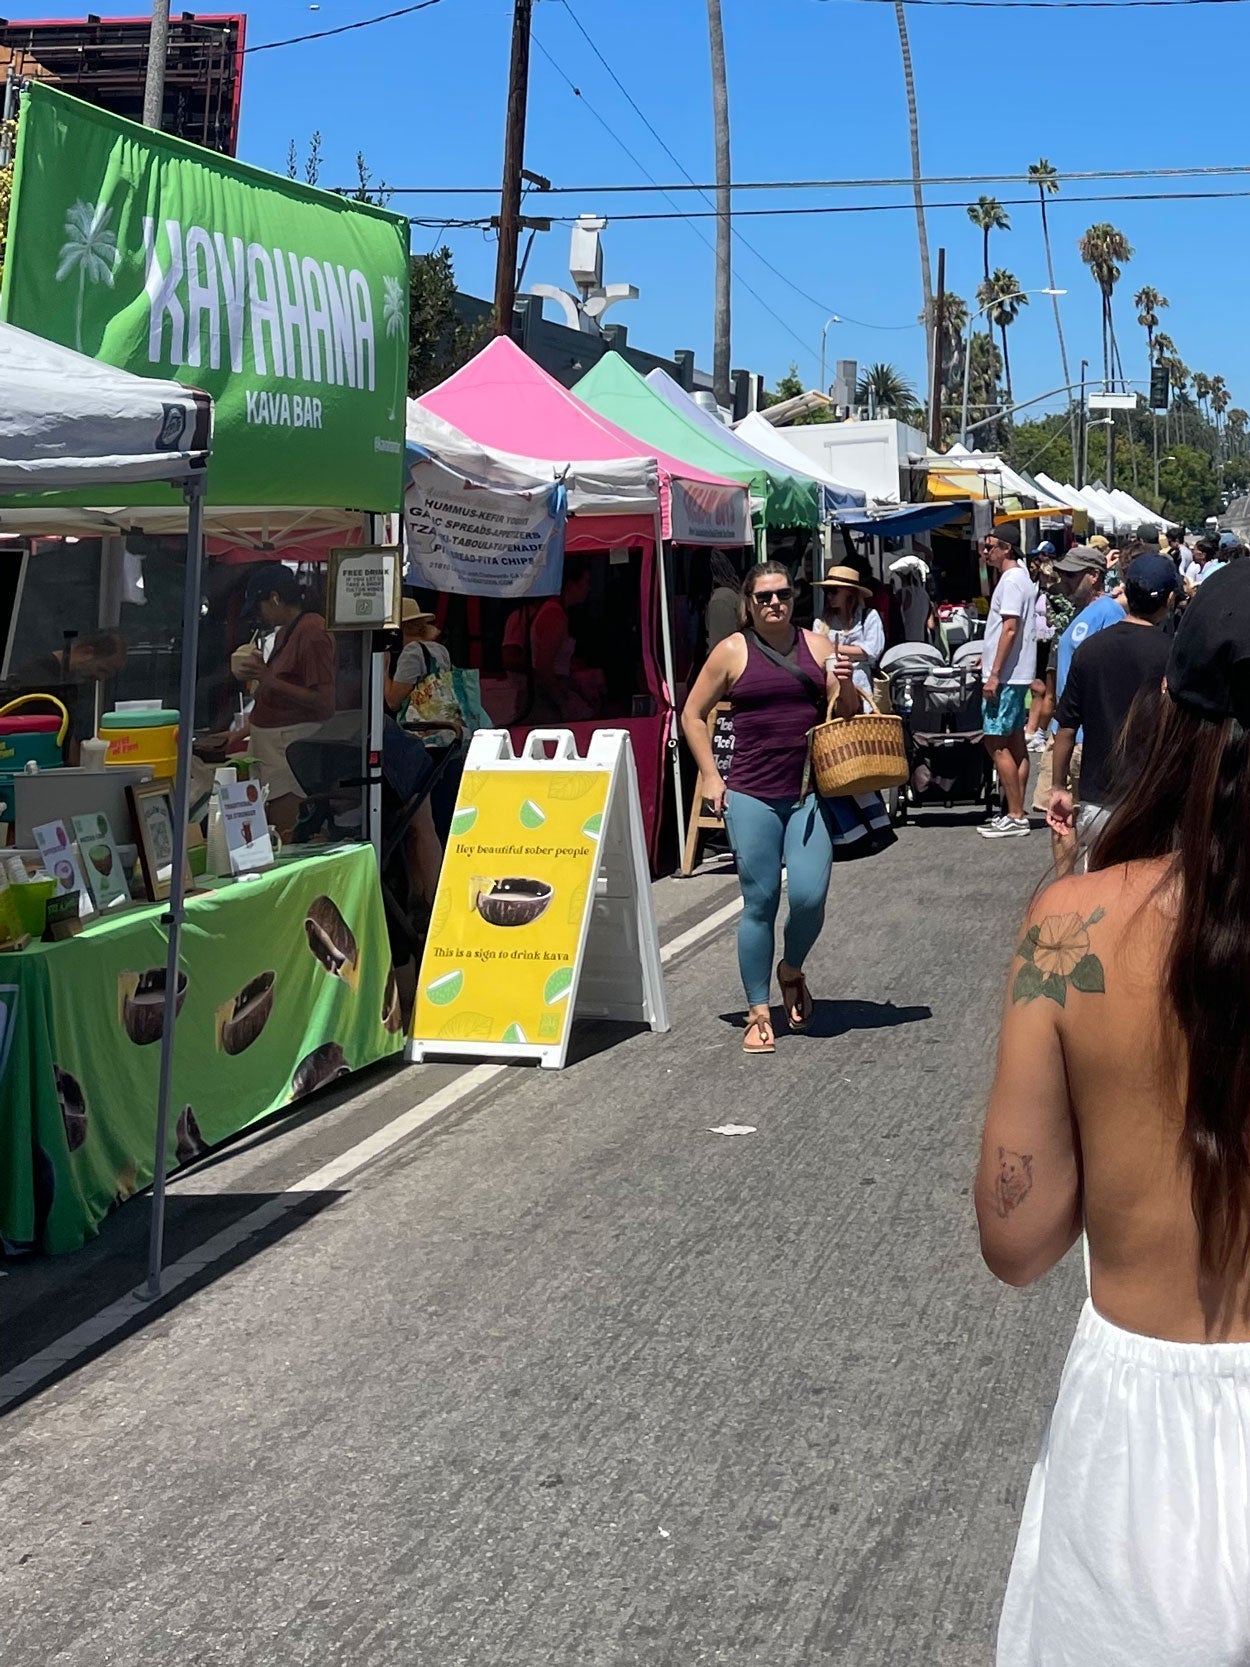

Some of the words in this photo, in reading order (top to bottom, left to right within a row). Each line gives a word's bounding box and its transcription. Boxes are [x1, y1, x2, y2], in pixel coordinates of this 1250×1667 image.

[143, 216, 375, 392] KAVAHANA
[246, 390, 292, 426] KAVA
[294, 396, 322, 430] BAR
[424, 498, 505, 525] HUMMUS-KEFIR
[343, 569, 363, 577] FREE
[364, 568, 390, 577] DRINK
[456, 843, 476, 858] Hey
[477, 844, 524, 855] beautiful
[525, 844, 554, 856] sober
[555, 845, 590, 858] people
[433, 947, 454, 959] This
[455, 948, 465, 959] is
[466, 951, 473, 959] a
[474, 948, 497, 963] sign
[498, 948, 509, 960] to
[510, 948, 541, 961] drink
[543, 950, 570, 962] kava
